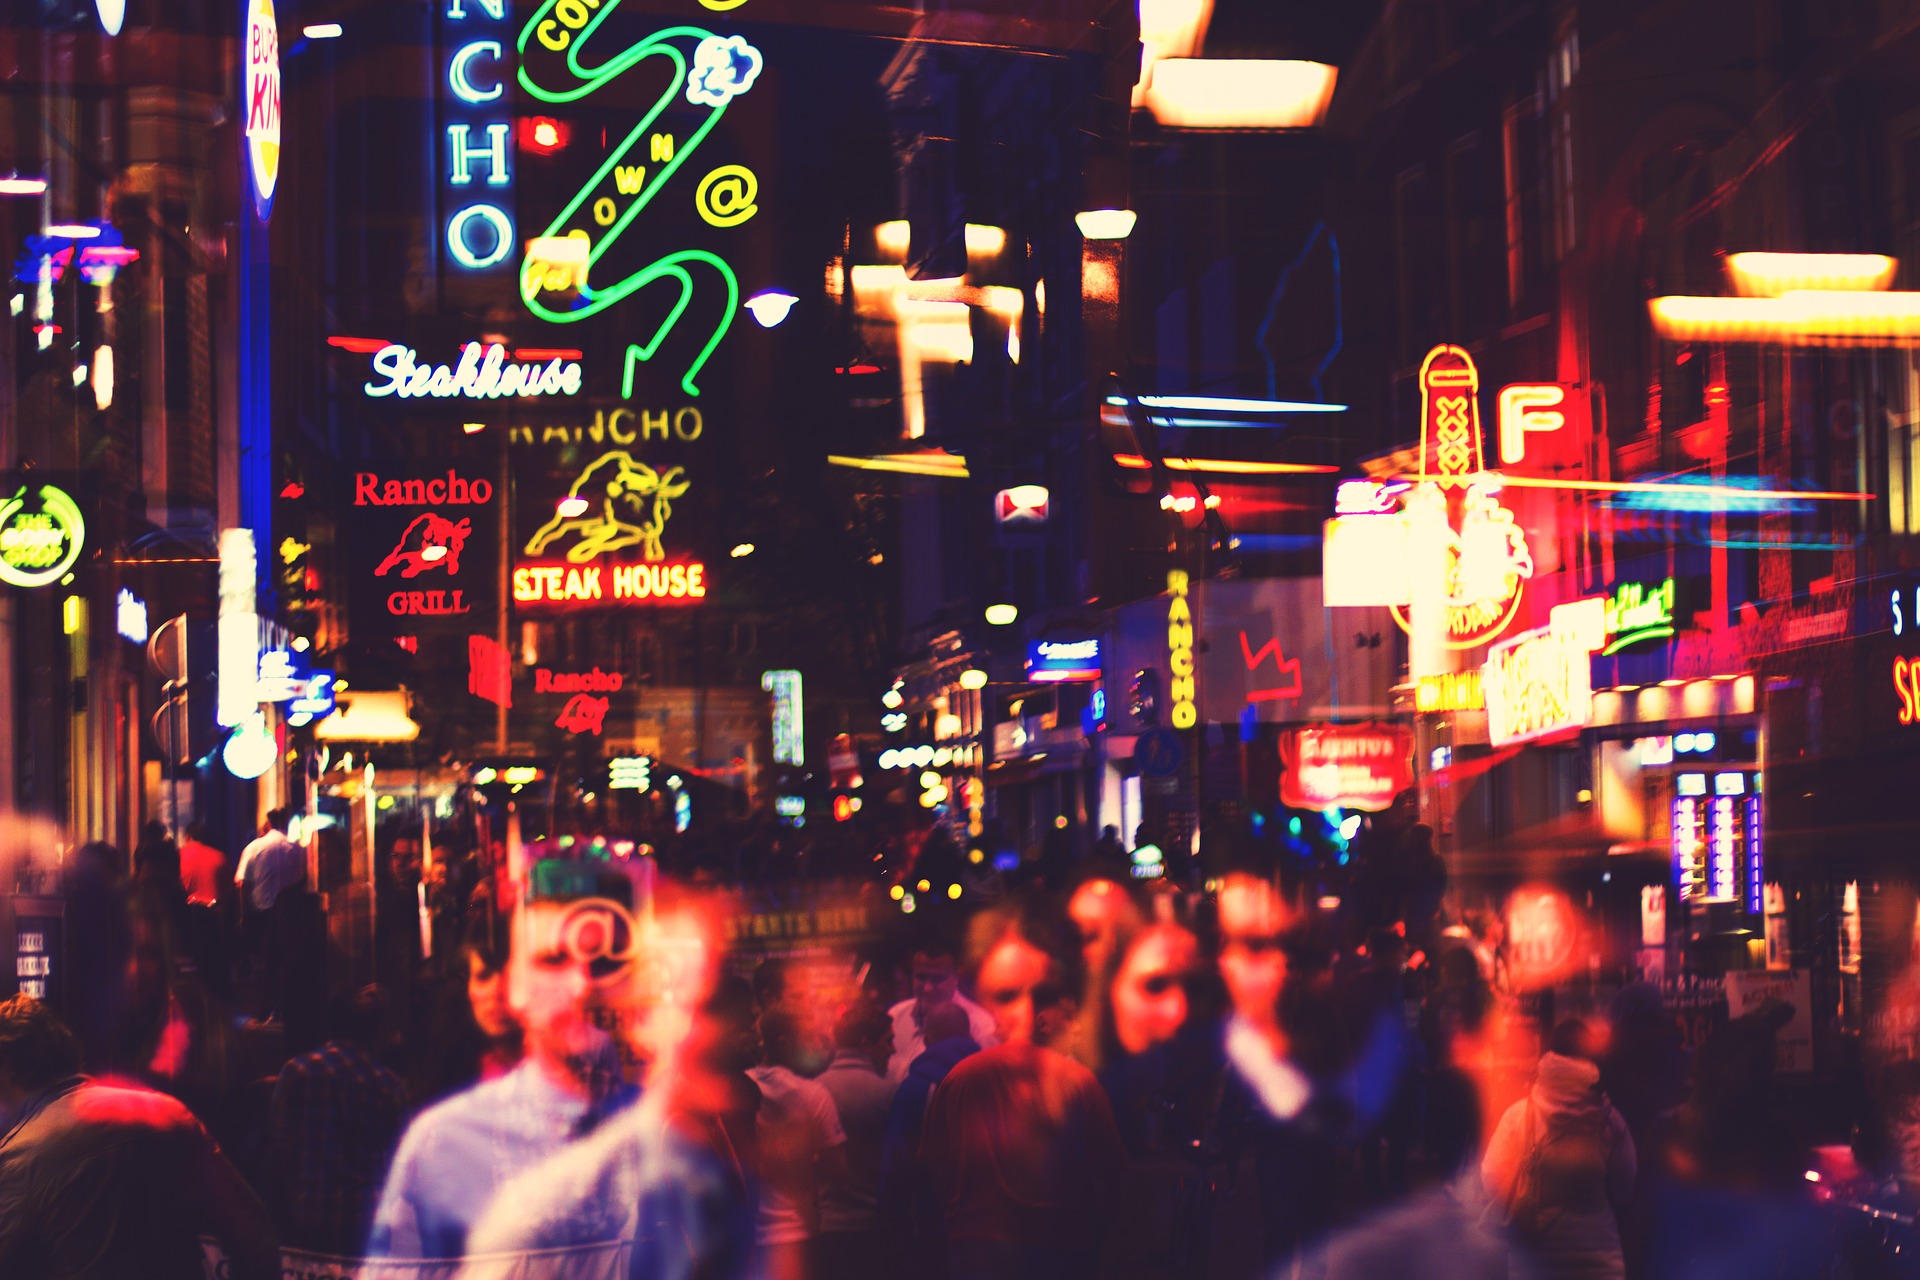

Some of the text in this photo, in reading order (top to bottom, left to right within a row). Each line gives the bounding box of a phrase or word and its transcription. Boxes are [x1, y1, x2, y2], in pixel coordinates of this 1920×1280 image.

[365, 341, 582, 399] Steakhouse
[354, 469, 493, 507] Rancho
[513, 564, 706, 601] STEAK HOUSE
[387, 590, 471, 616] GRILL
[1166, 569, 1198, 729] RANCHO
[535, 668, 623, 693] Rancho
